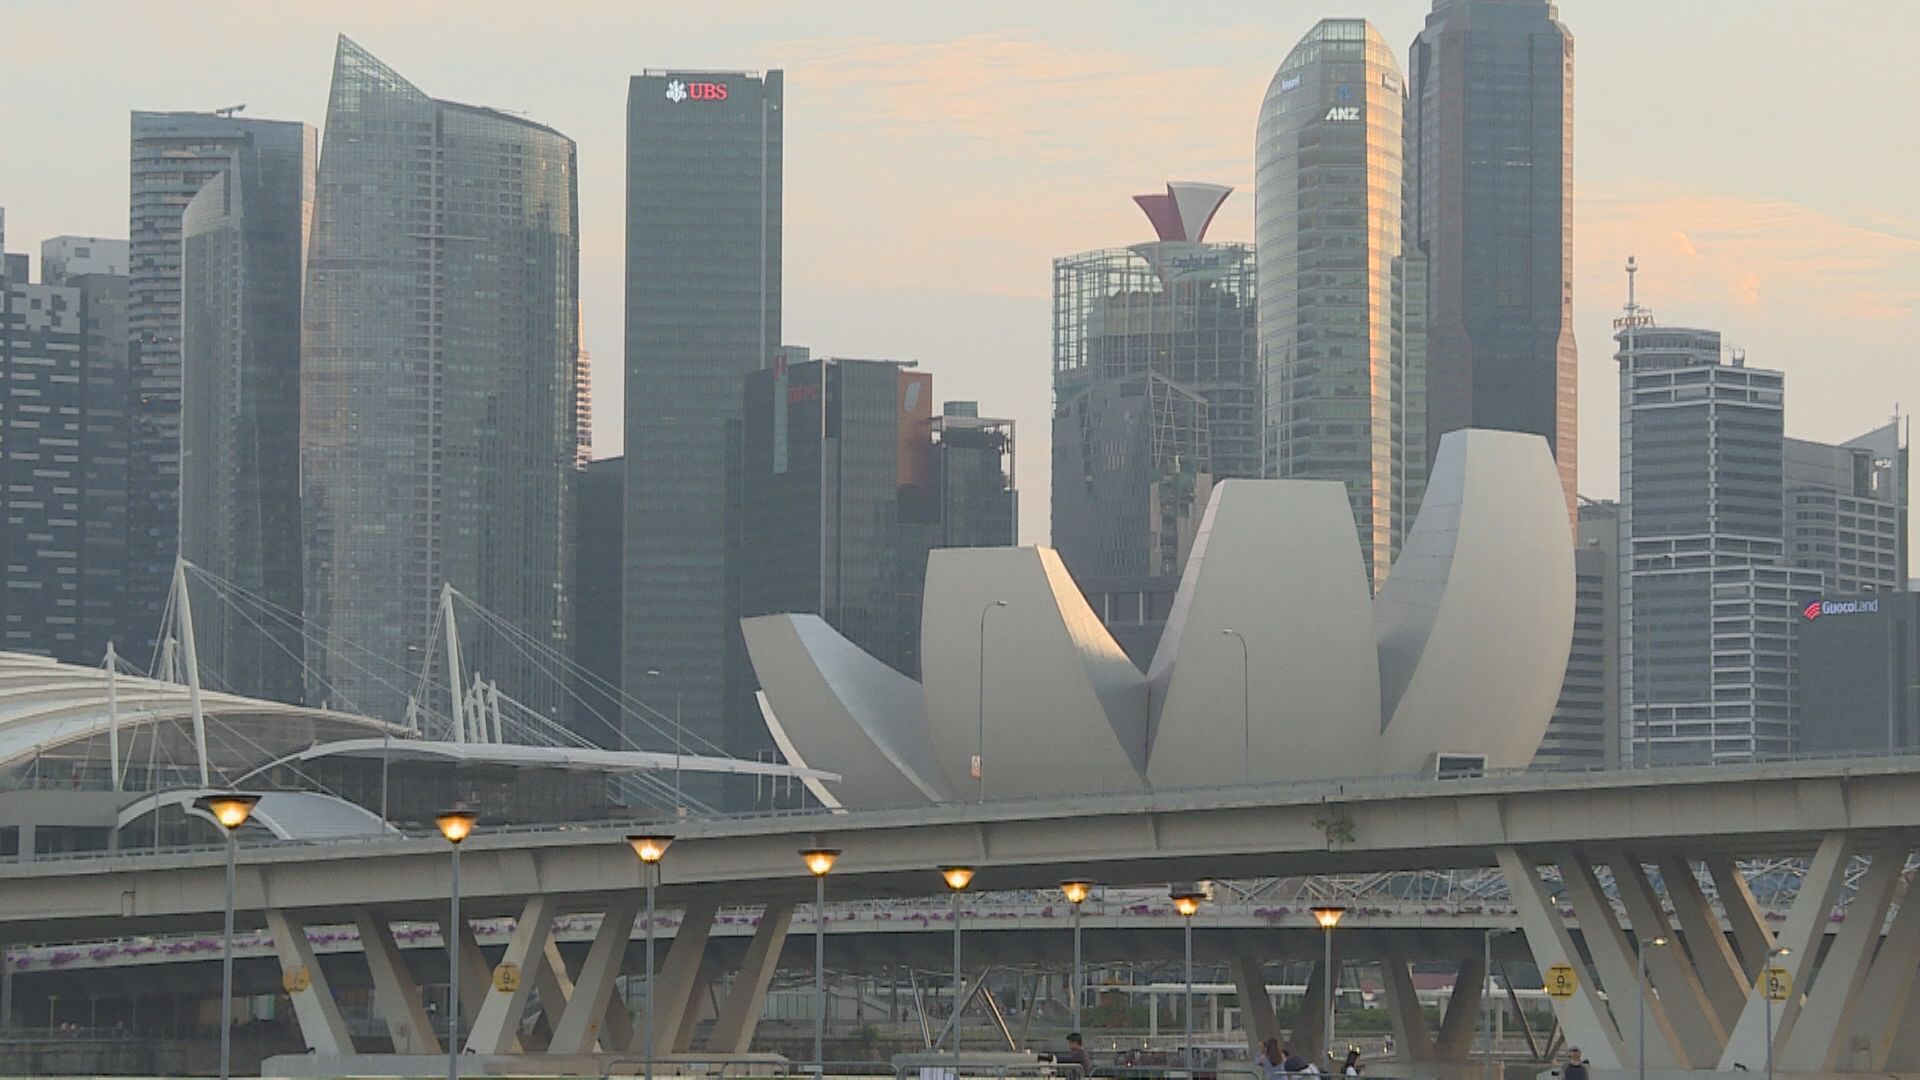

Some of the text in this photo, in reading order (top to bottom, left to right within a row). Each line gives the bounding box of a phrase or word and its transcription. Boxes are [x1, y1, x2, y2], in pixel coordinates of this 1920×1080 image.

[689, 82, 728, 100] UBS
[1324, 106, 1360, 120] ANZ
[1822, 599, 1878, 614] GuocoLand
